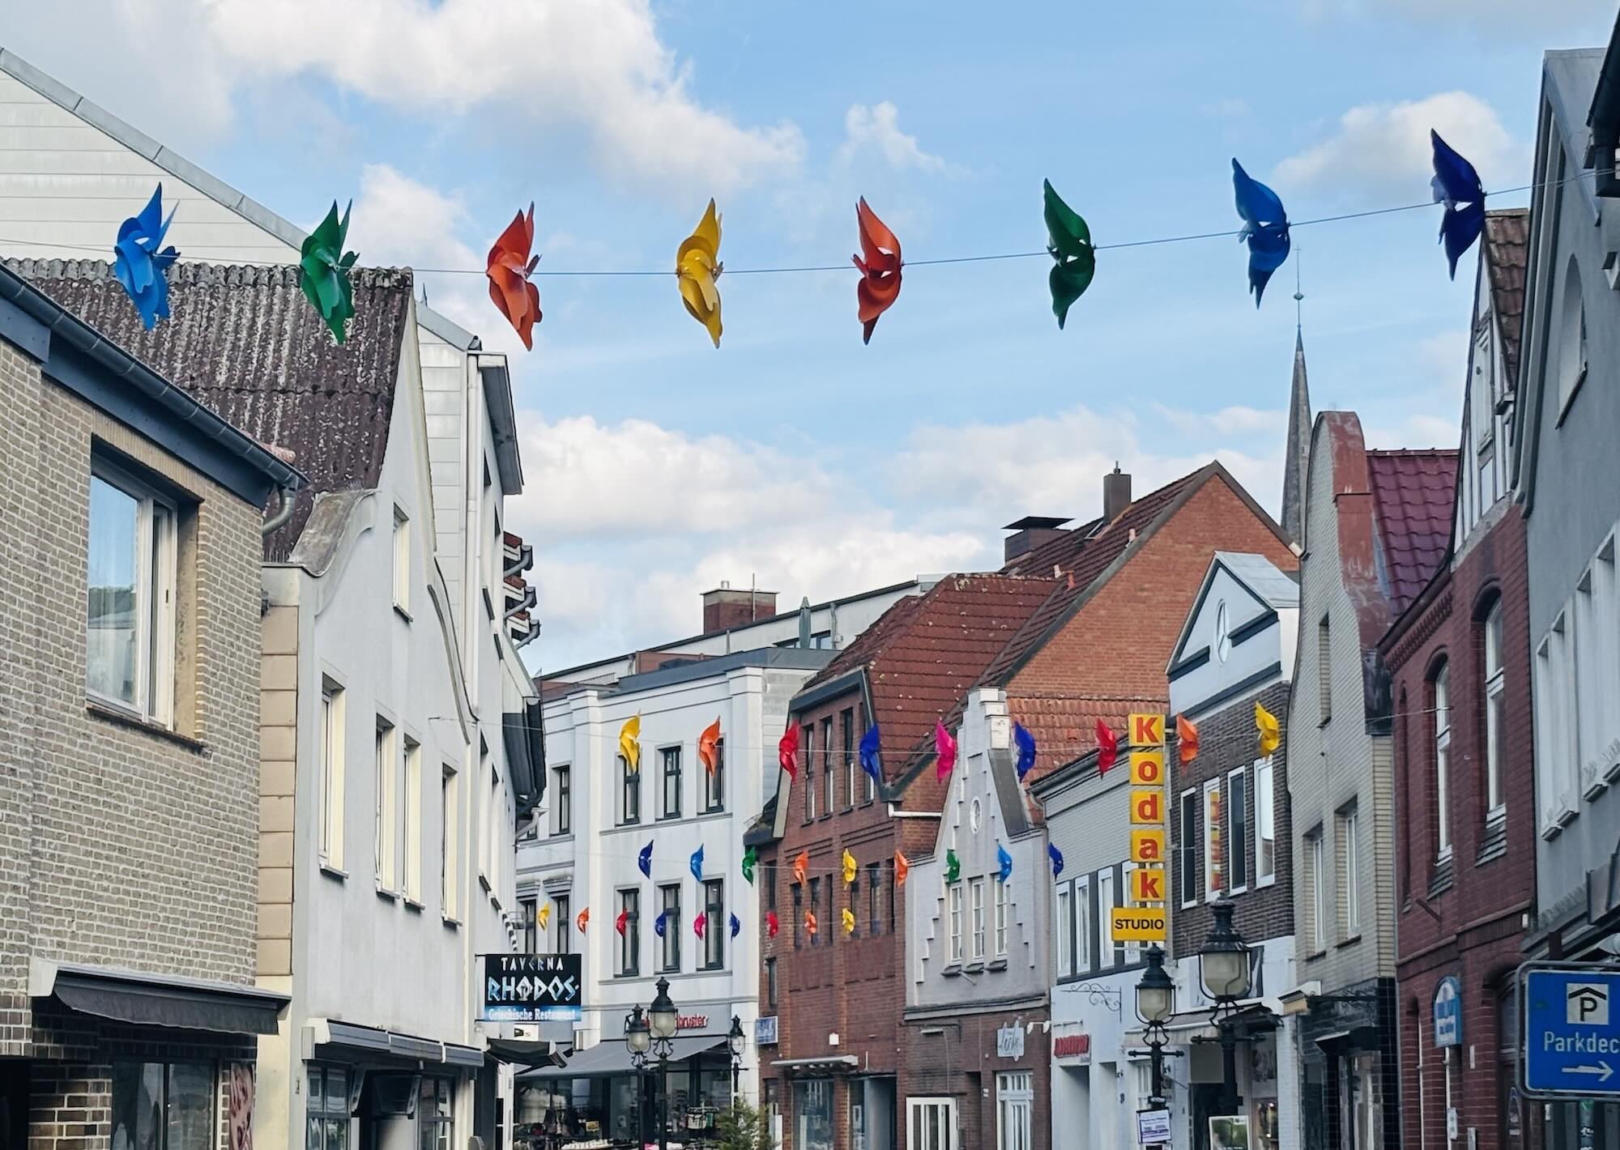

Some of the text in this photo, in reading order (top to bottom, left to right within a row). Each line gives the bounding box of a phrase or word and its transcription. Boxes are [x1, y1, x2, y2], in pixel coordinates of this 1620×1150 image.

[1136, 717, 1160, 899] Kodak
[1114, 919, 1164, 930] STUDIO
[501, 957, 564, 971] TAVERNA
[1579, 996, 1597, 1022] P
